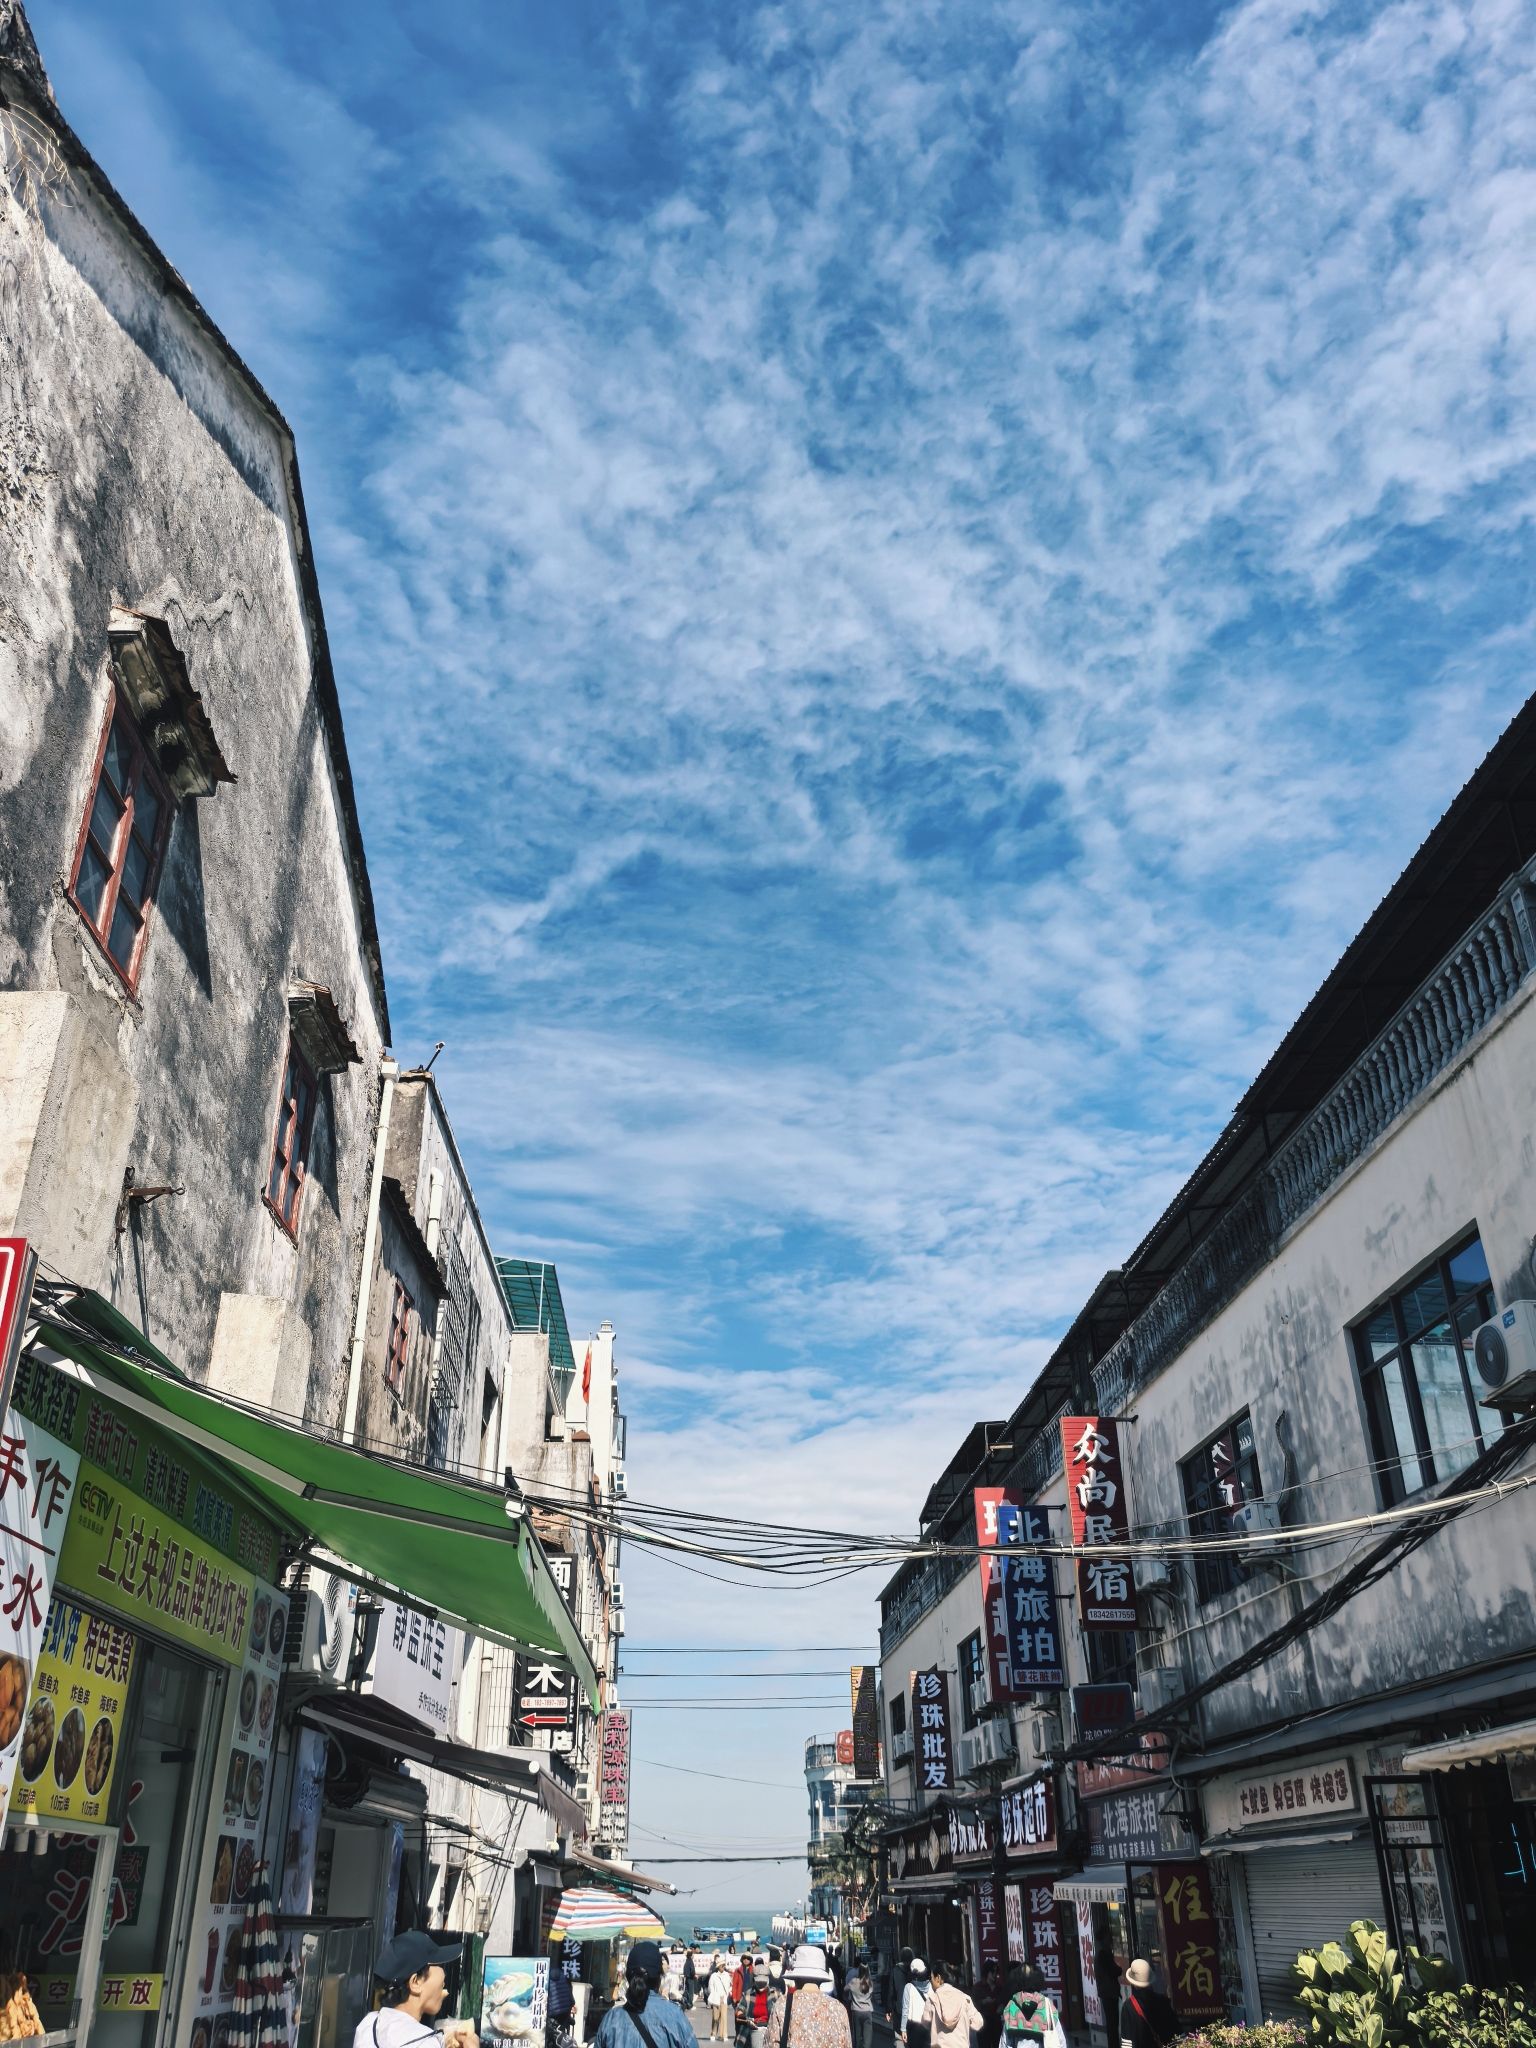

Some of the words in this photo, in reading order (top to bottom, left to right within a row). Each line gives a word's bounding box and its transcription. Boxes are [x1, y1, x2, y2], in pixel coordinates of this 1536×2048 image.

[11, 1356, 80, 1441] 美味搭配
[84, 1400, 138, 1480] 清甜可口
[80, 1480, 114, 1520] CCTV
[1073, 1423, 1130, 1601] 众尚民宿
[97, 1503, 249, 1651] 上过央视品牌的虾饼
[1008, 1511, 1055, 1663] 北海旅拍
[83, 1613, 134, 1685] 特色美食
[918, 1674, 948, 1788] 珍珠批发
[1001, 1780, 1047, 1847] 珍珠超市
[1103, 1793, 1157, 1839] 北海旅拍
[1272, 1777, 1307, 1811] 臭豆腐
[562, 1938, 582, 1980] 珍珠
[980, 1881, 998, 1962] 珍珠工厂一
[1030, 1887, 1063, 2013] 珍珠超市
[1164, 1875, 1216, 1998] 住宿
